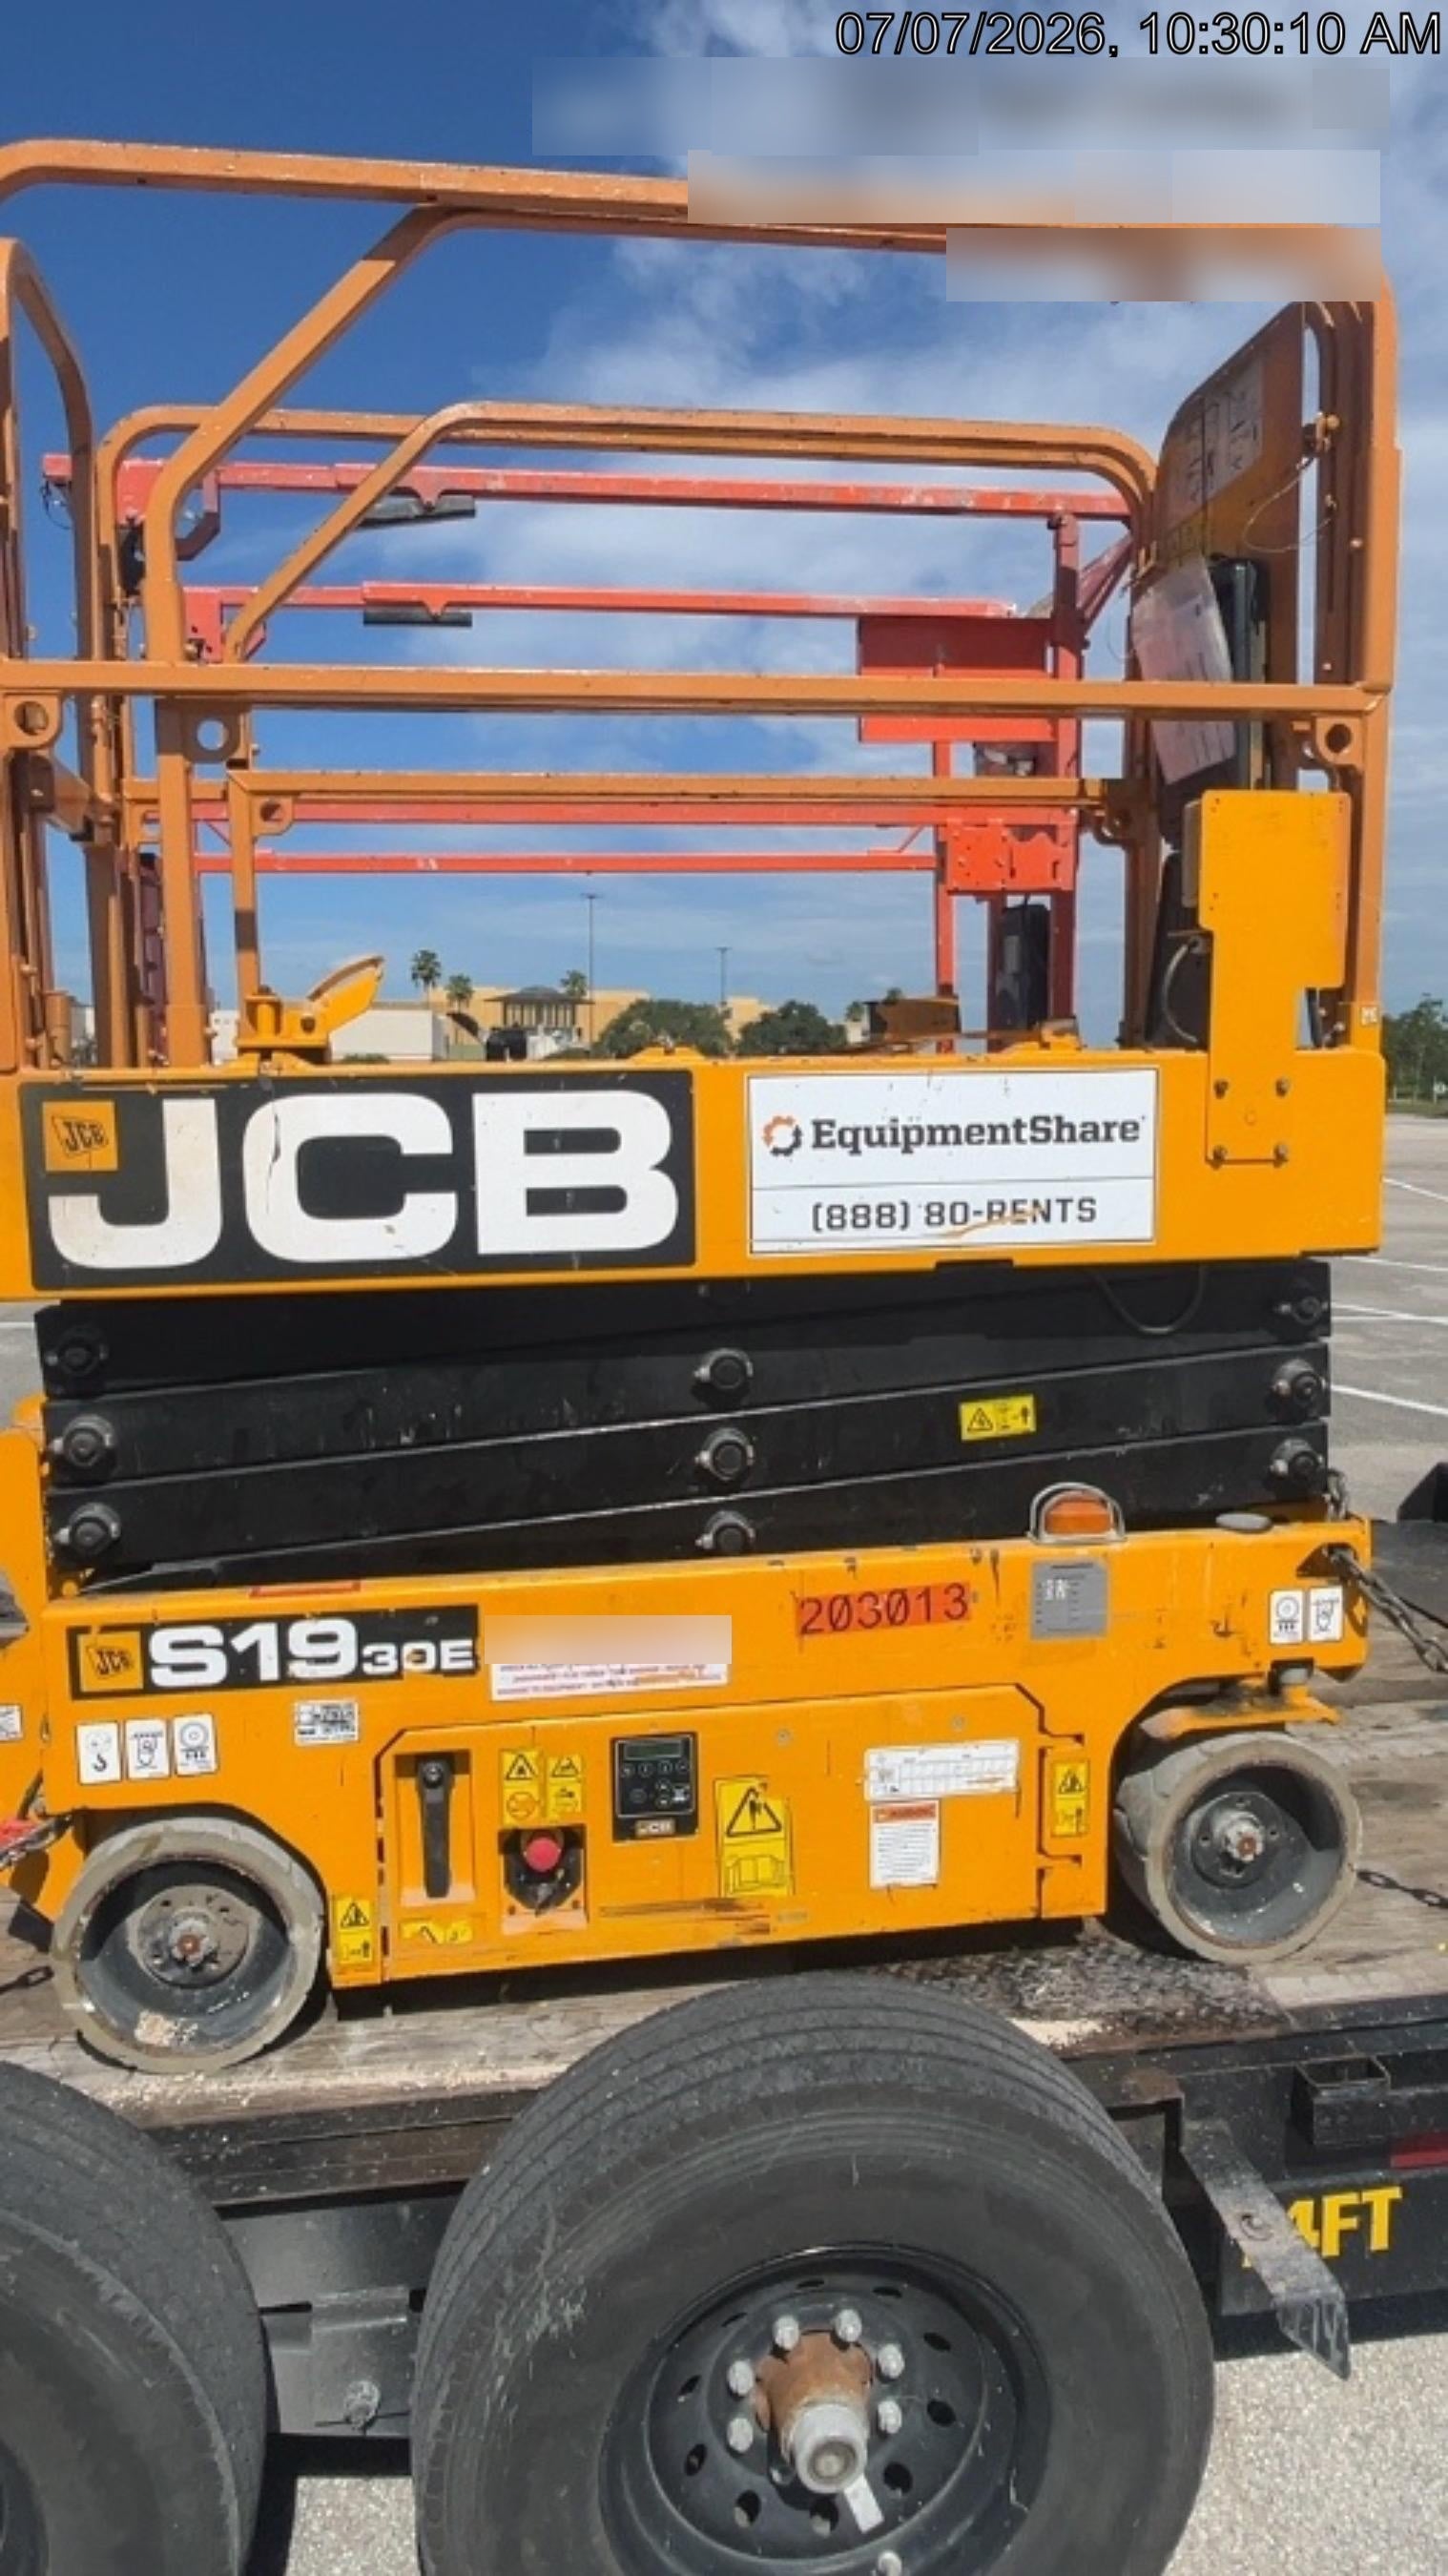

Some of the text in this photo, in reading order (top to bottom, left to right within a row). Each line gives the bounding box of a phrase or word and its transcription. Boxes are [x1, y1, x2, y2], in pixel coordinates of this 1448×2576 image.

[62, 1120, 107, 1152] JCB
[811, 1114, 1141, 1154] EquipmentShare
[49, 1091, 678, 1269] JCB
[812, 1197, 1098, 1233] (888) 80-RENTS
[798, 1583, 969, 1635] 203013
